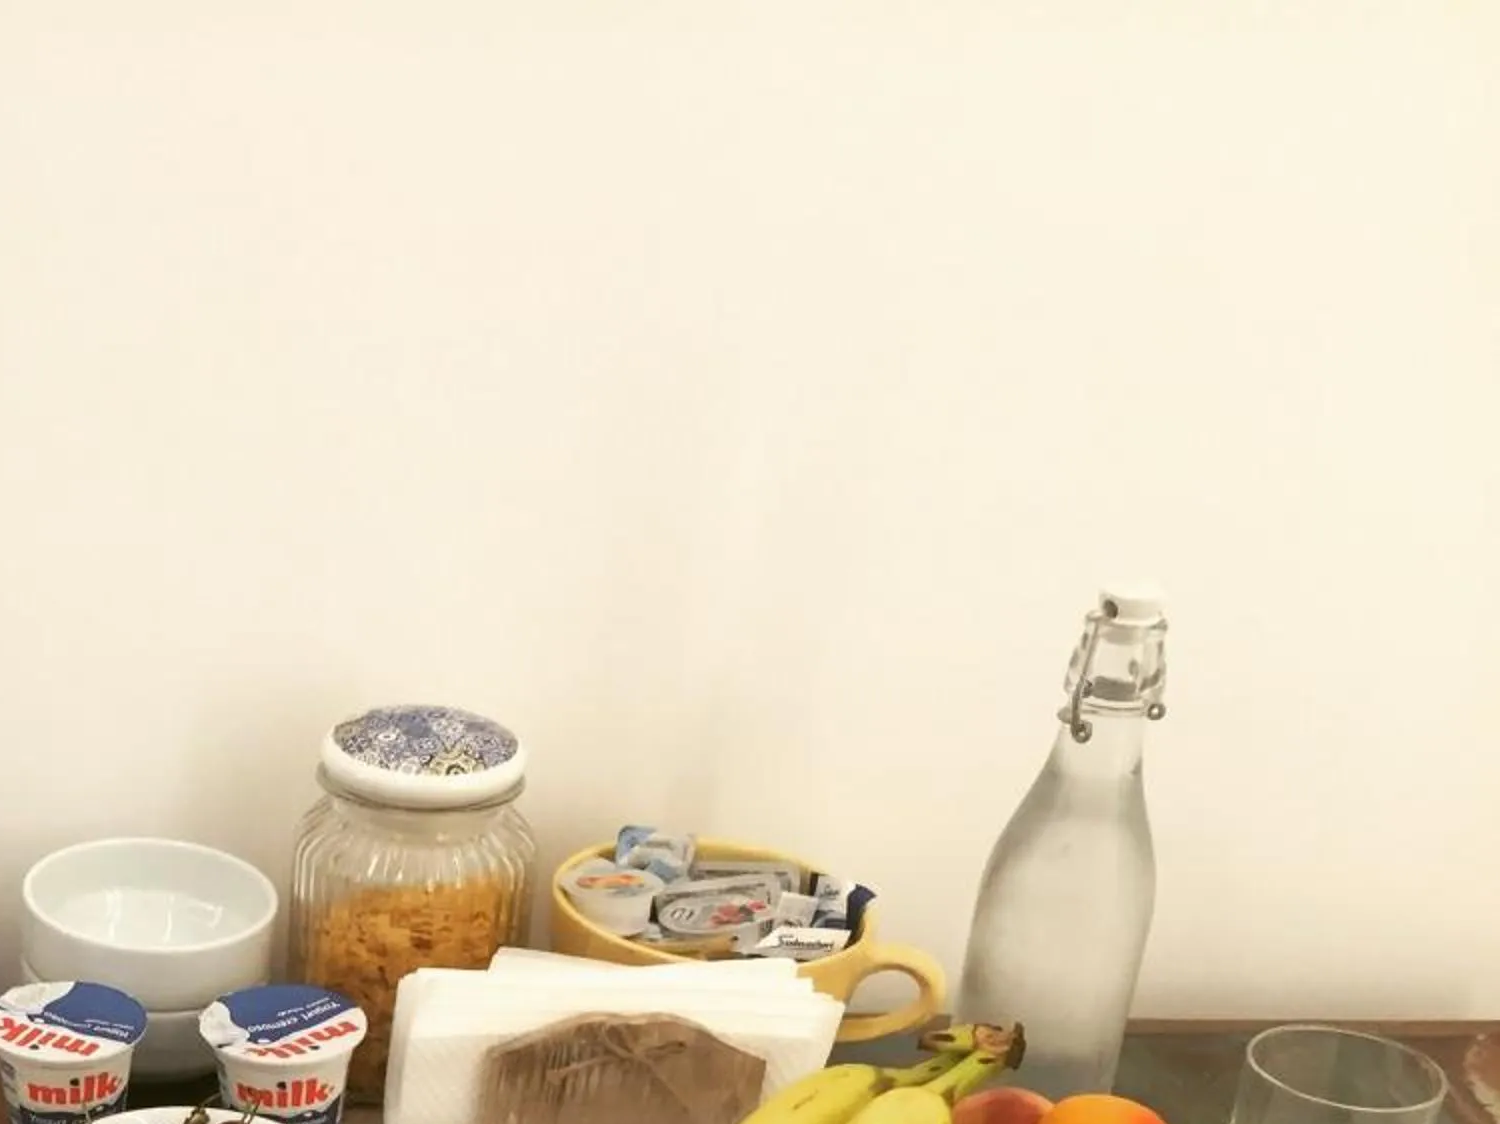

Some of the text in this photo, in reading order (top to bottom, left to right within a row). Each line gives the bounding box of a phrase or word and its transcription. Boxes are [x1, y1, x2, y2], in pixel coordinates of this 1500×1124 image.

[244, 1020, 359, 1060] milk
[27, 1072, 118, 1105] milk
[236, 1078, 329, 1108] milk
